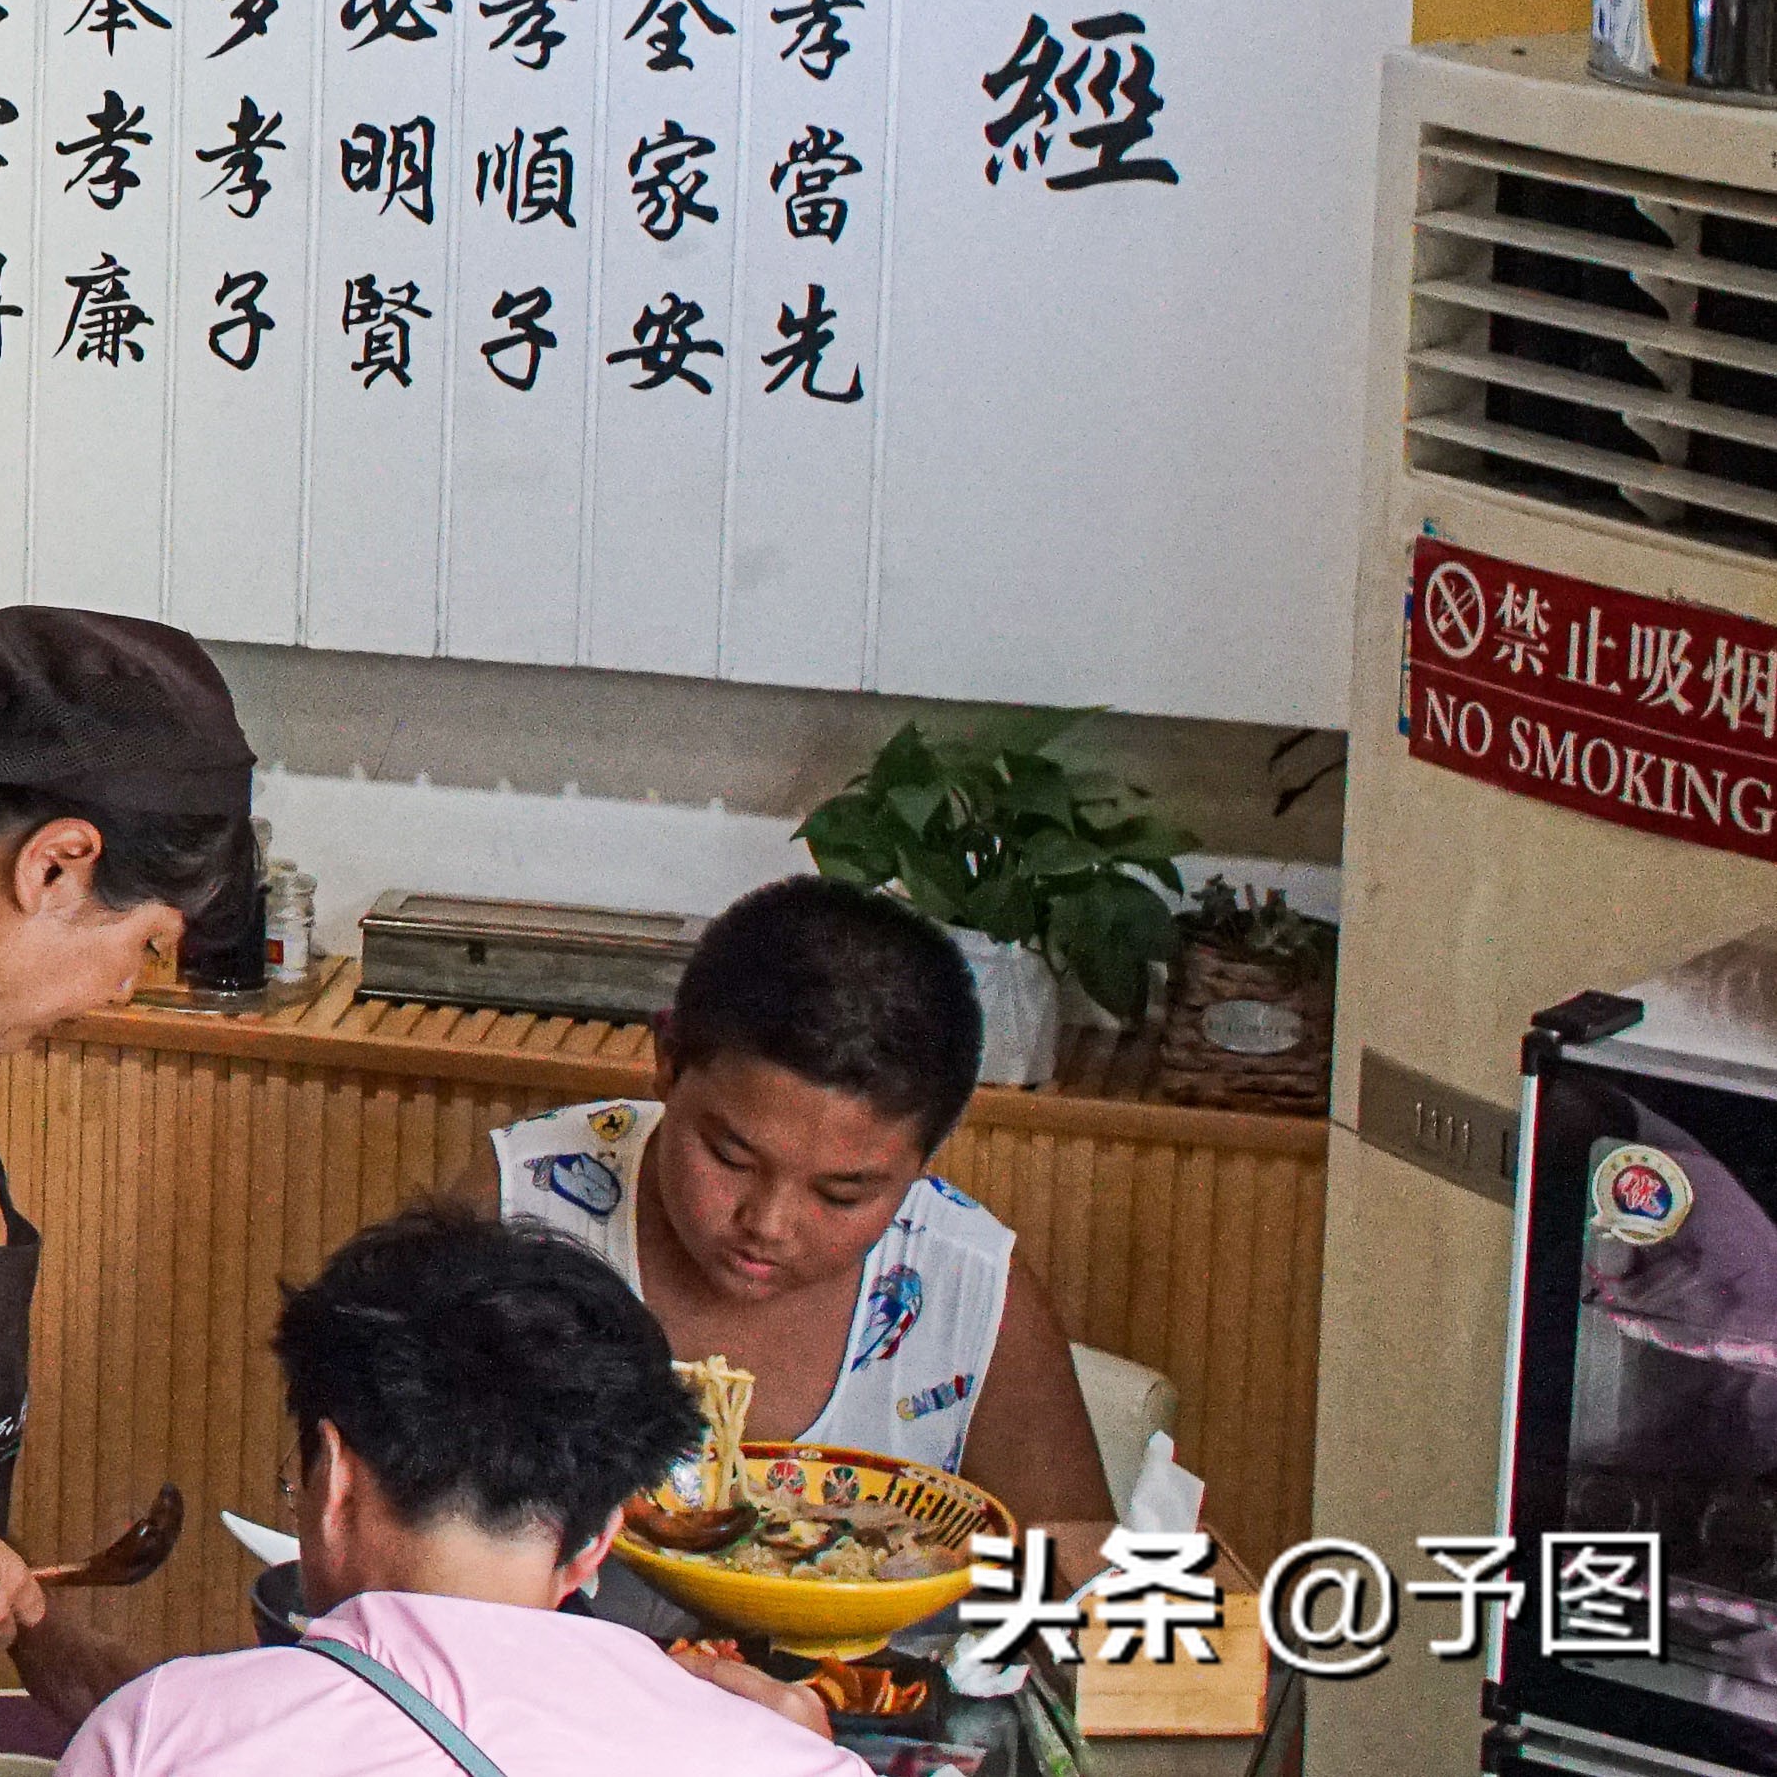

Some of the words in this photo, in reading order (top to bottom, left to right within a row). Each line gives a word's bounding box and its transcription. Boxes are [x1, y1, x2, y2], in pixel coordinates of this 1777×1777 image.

[1493, 581, 1777, 740] 禁止吸烟
[1423, 687, 1493, 758] NO
[1508, 714, 1777, 836] SMOKING
